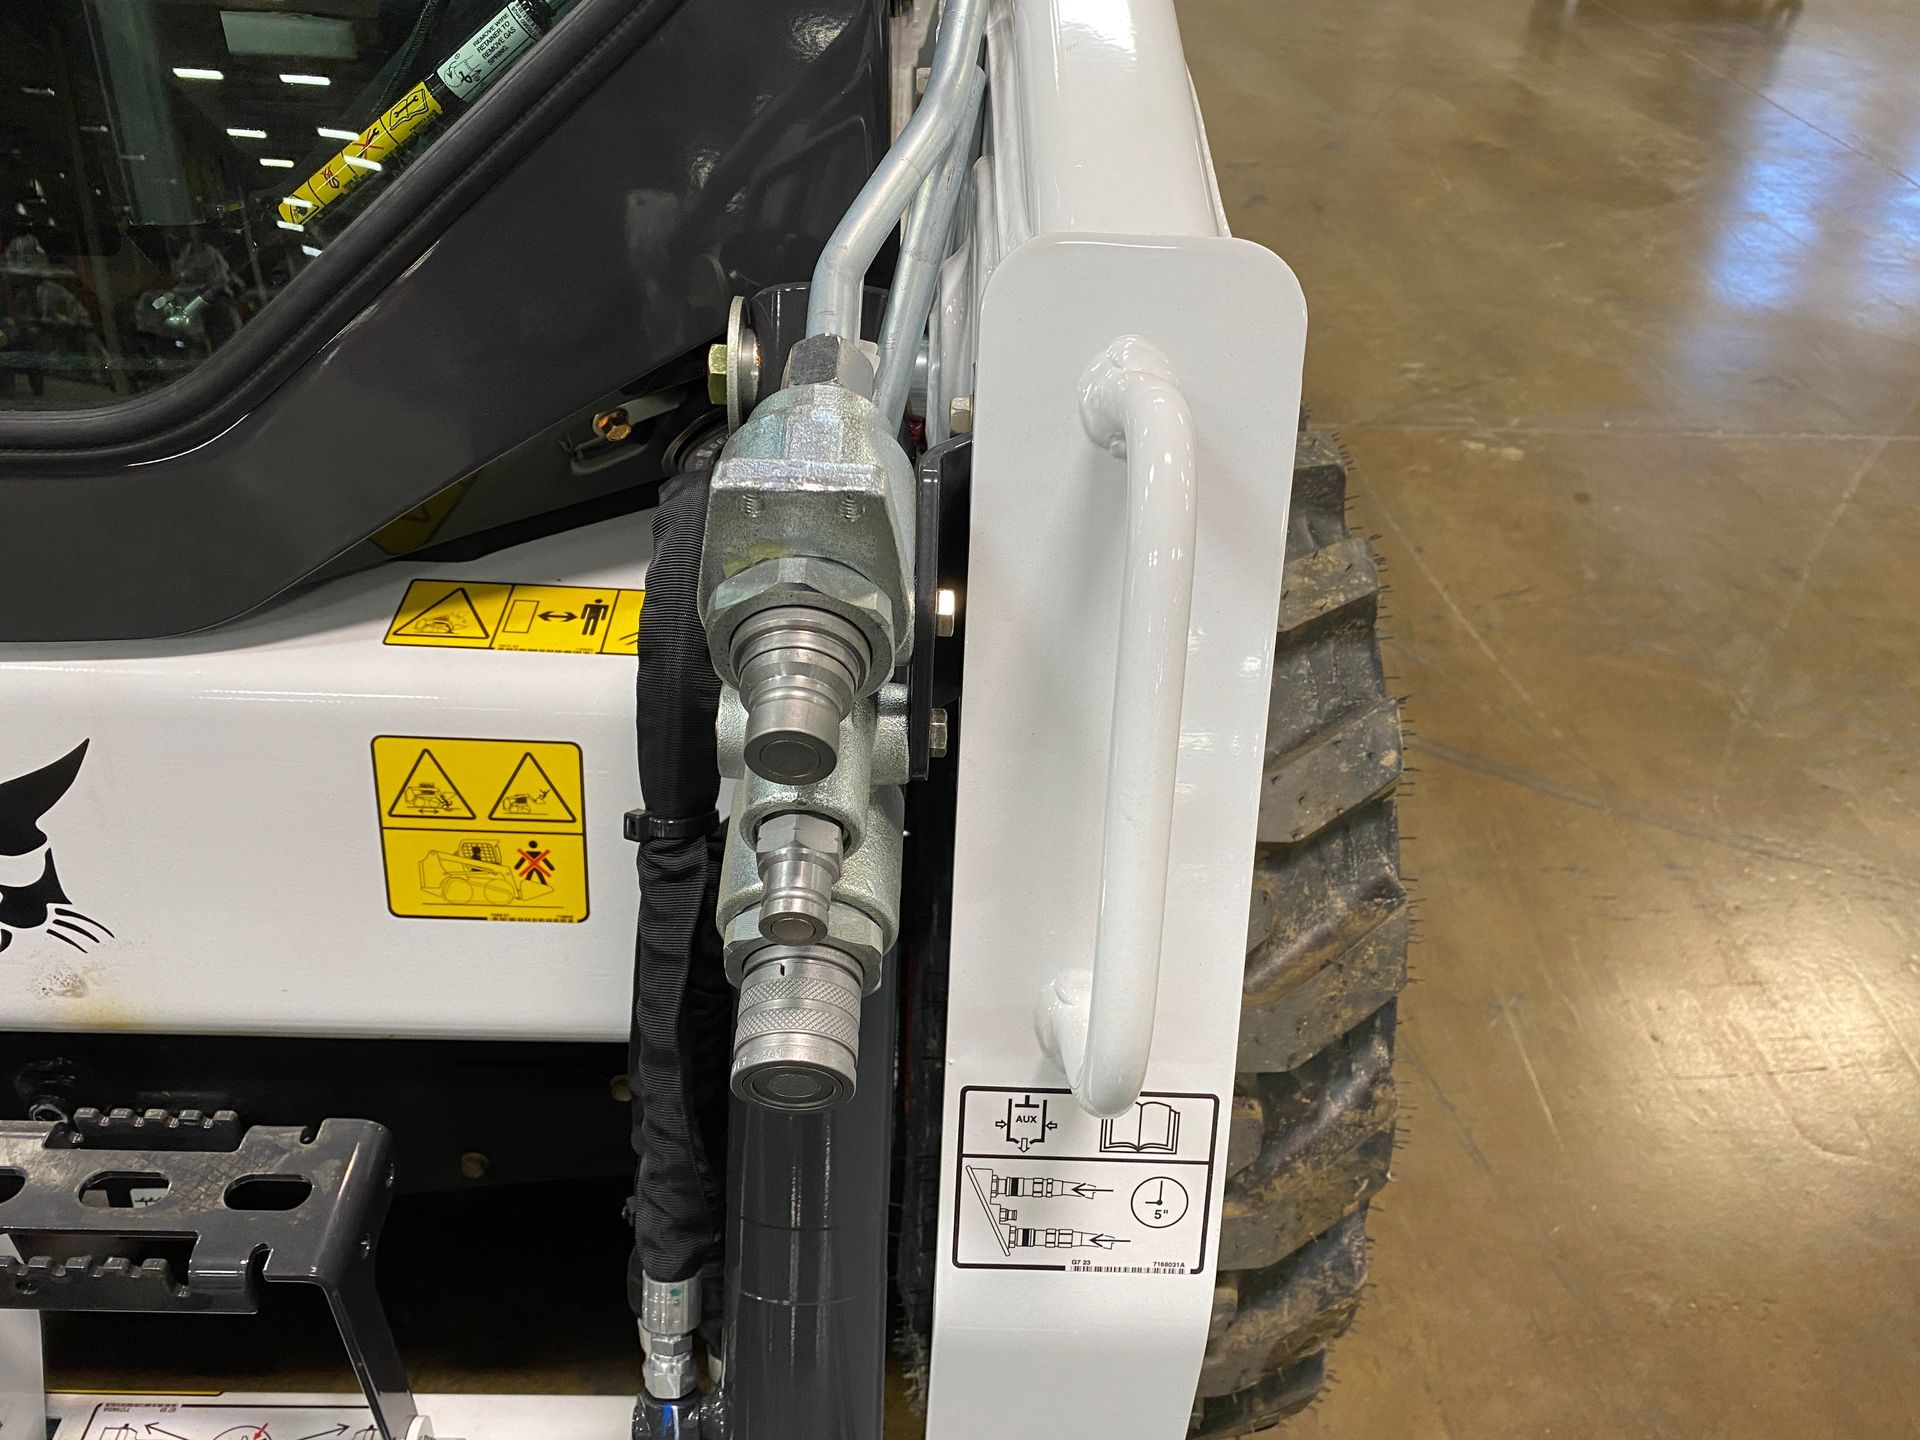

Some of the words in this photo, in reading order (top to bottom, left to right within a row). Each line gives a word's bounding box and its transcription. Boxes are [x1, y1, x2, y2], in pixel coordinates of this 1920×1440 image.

[473, 25, 495, 47] REMOVE
[494, 12, 509, 27] WIRE
[477, 28, 503, 53] RETAINER
[501, 20, 510, 30] TO
[482, 36, 505, 60] REMOVE
[503, 26, 516, 39] GAS
[1015, 1115, 1037, 1123] AUX
[1154, 1209, 1168, 1219] 5"
